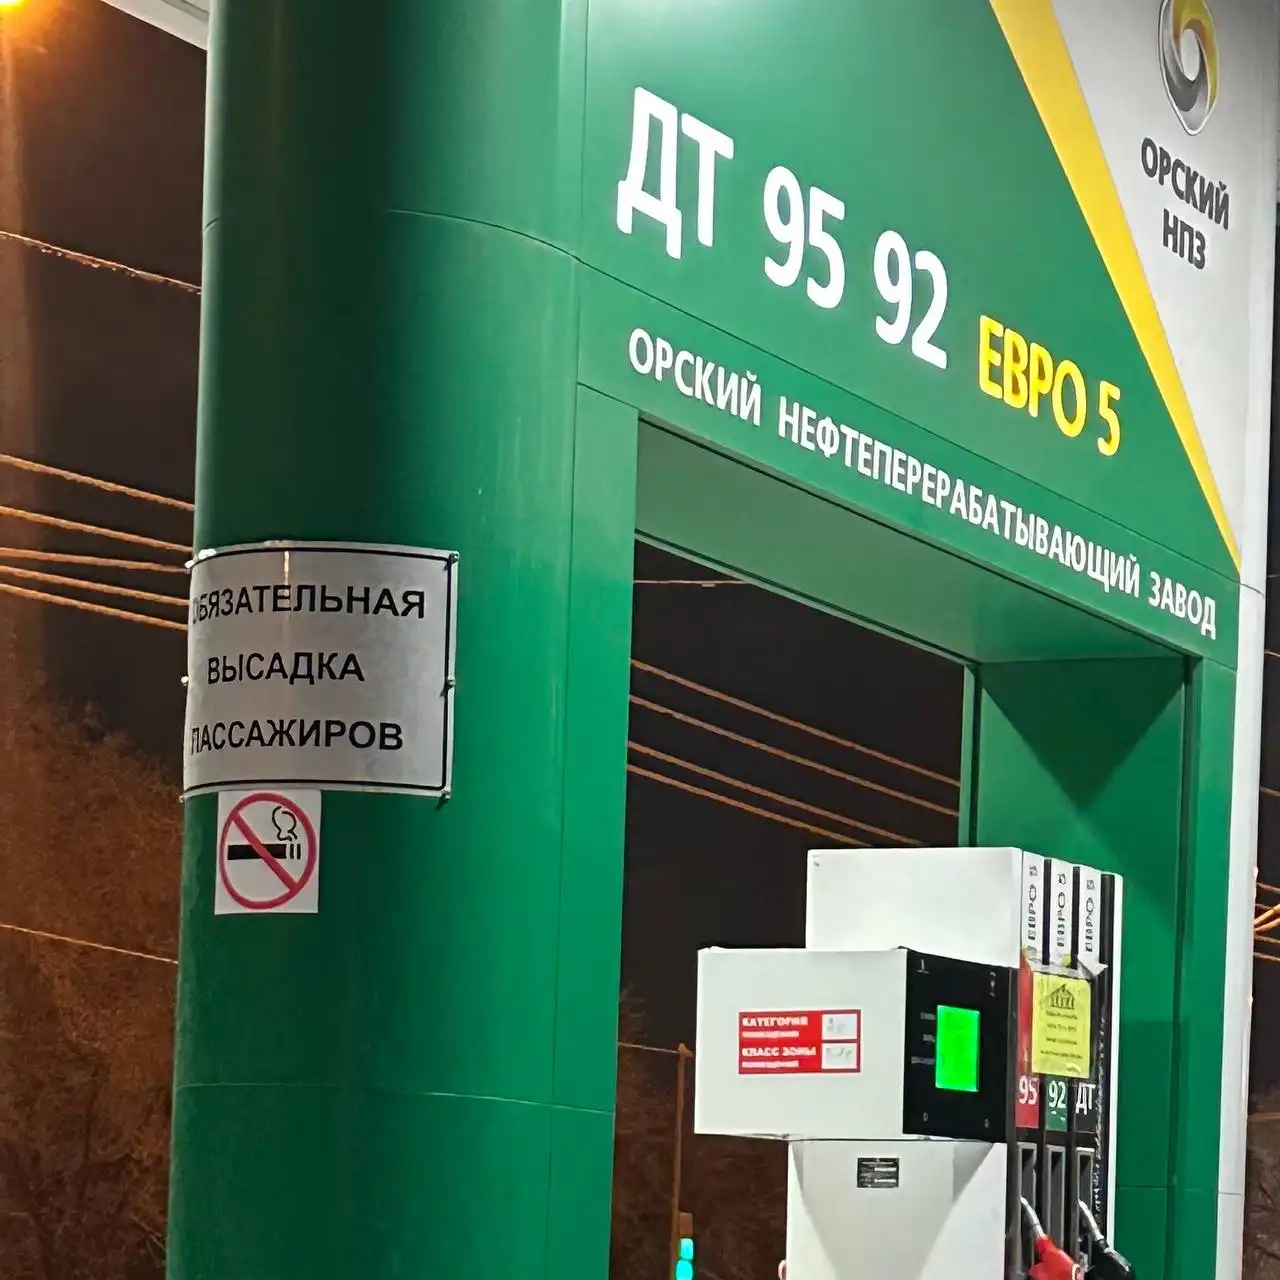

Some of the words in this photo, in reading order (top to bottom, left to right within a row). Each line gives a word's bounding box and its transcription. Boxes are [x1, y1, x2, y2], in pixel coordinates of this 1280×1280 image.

[1140, 137, 1229, 231] ОРСКИЙ
[616, 86, 735, 260] ДТ
[763, 165, 846, 309] 95
[873, 230, 948, 370] 92
[1162, 209, 1206, 270] НПЗ
[978, 315, 1087, 438] ЕВРО
[1097, 380, 1121, 457] 5
[628, 328, 762, 427] ОРСКИЙ
[778, 395, 1141, 599] НЕФТЕПЕРЕРАБАТЫВАЮЩИЙ
[1148, 571, 1216, 641] ЗАВОД
[207, 651, 366, 686] ВЫСАДКА
[191, 718, 404, 755] ПАССАЖИРОВ
[1018, 1076, 1038, 1105] 95
[1048, 1080, 1067, 1109] 92
[1075, 1082, 1096, 1115] ДТ
